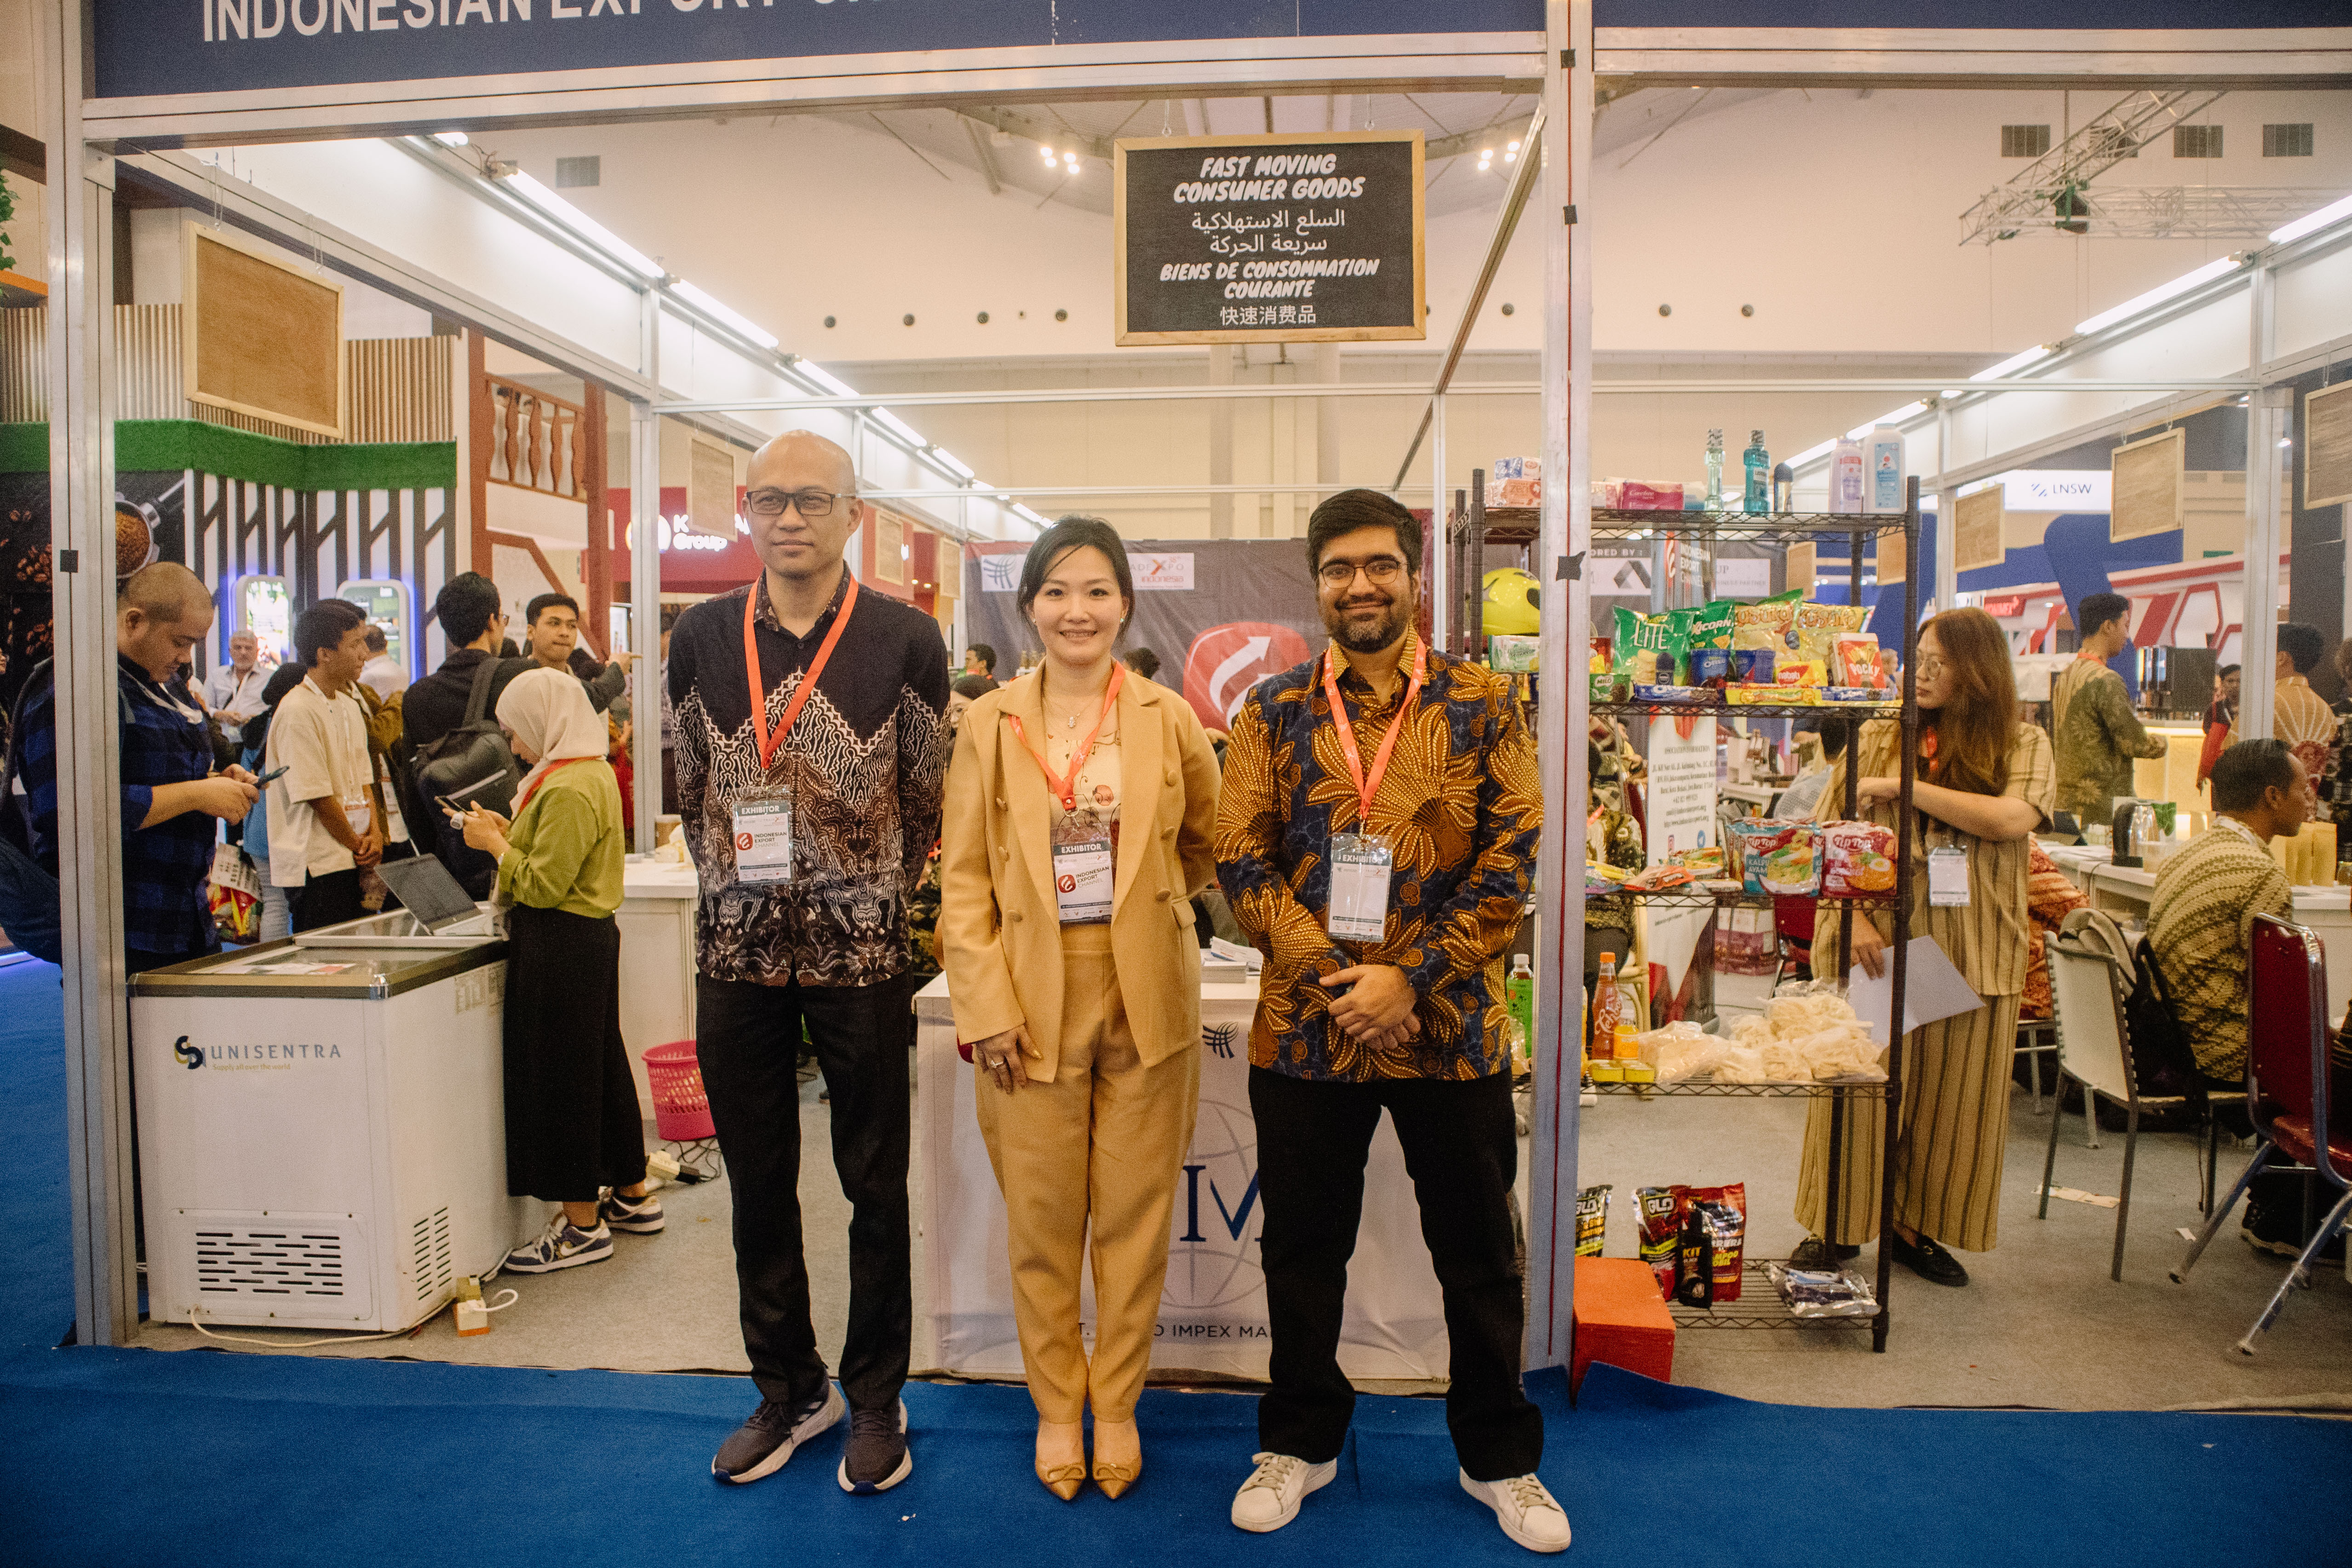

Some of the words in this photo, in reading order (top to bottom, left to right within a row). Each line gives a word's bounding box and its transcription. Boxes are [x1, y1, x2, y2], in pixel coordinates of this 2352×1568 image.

[1200, 156, 1251, 178] FAST
[1254, 154, 1337, 177] MOVING
[1174, 179, 1287, 203] CONSUMER
[1291, 176, 1365, 200] GOODS
[1192, 210, 1289, 234] الاستهلاكية
[1296, 209, 1345, 235] السلع
[1210, 235, 1264, 258] الحركة
[1271, 234, 1327, 256] سريعة
[1160, 263, 1212, 281] BIENS
[1216, 261, 1239, 280] DE
[1243, 258, 1379, 279] CONSOMMATION
[1224, 279, 1315, 299] COURANTE
[1220, 304, 1317, 326] 快速消费品
[2053, 482, 2092, 494] LNSW
[1633, 622, 1670, 650] LITE
[1849, 662, 1880, 677] POCKY
[741, 805, 780, 815] EXHIBITOR
[1061, 843, 1102, 854] EXHIBITOR
[1761, 838, 1777, 848] Top
[1076, 866, 1110, 879] INDONESIAN
[1077, 874, 1098, 884] EXPORT
[1078, 879, 1104, 888] CHANNEL
[211, 1043, 341, 1060] UNISENTRA
[1682, 1246, 1702, 1258] KIT
[1712, 1258, 1731, 1267] OBIL
[1173, 1324, 1231, 1338] IMPEX
[1239, 1325, 1268, 1338] MA
